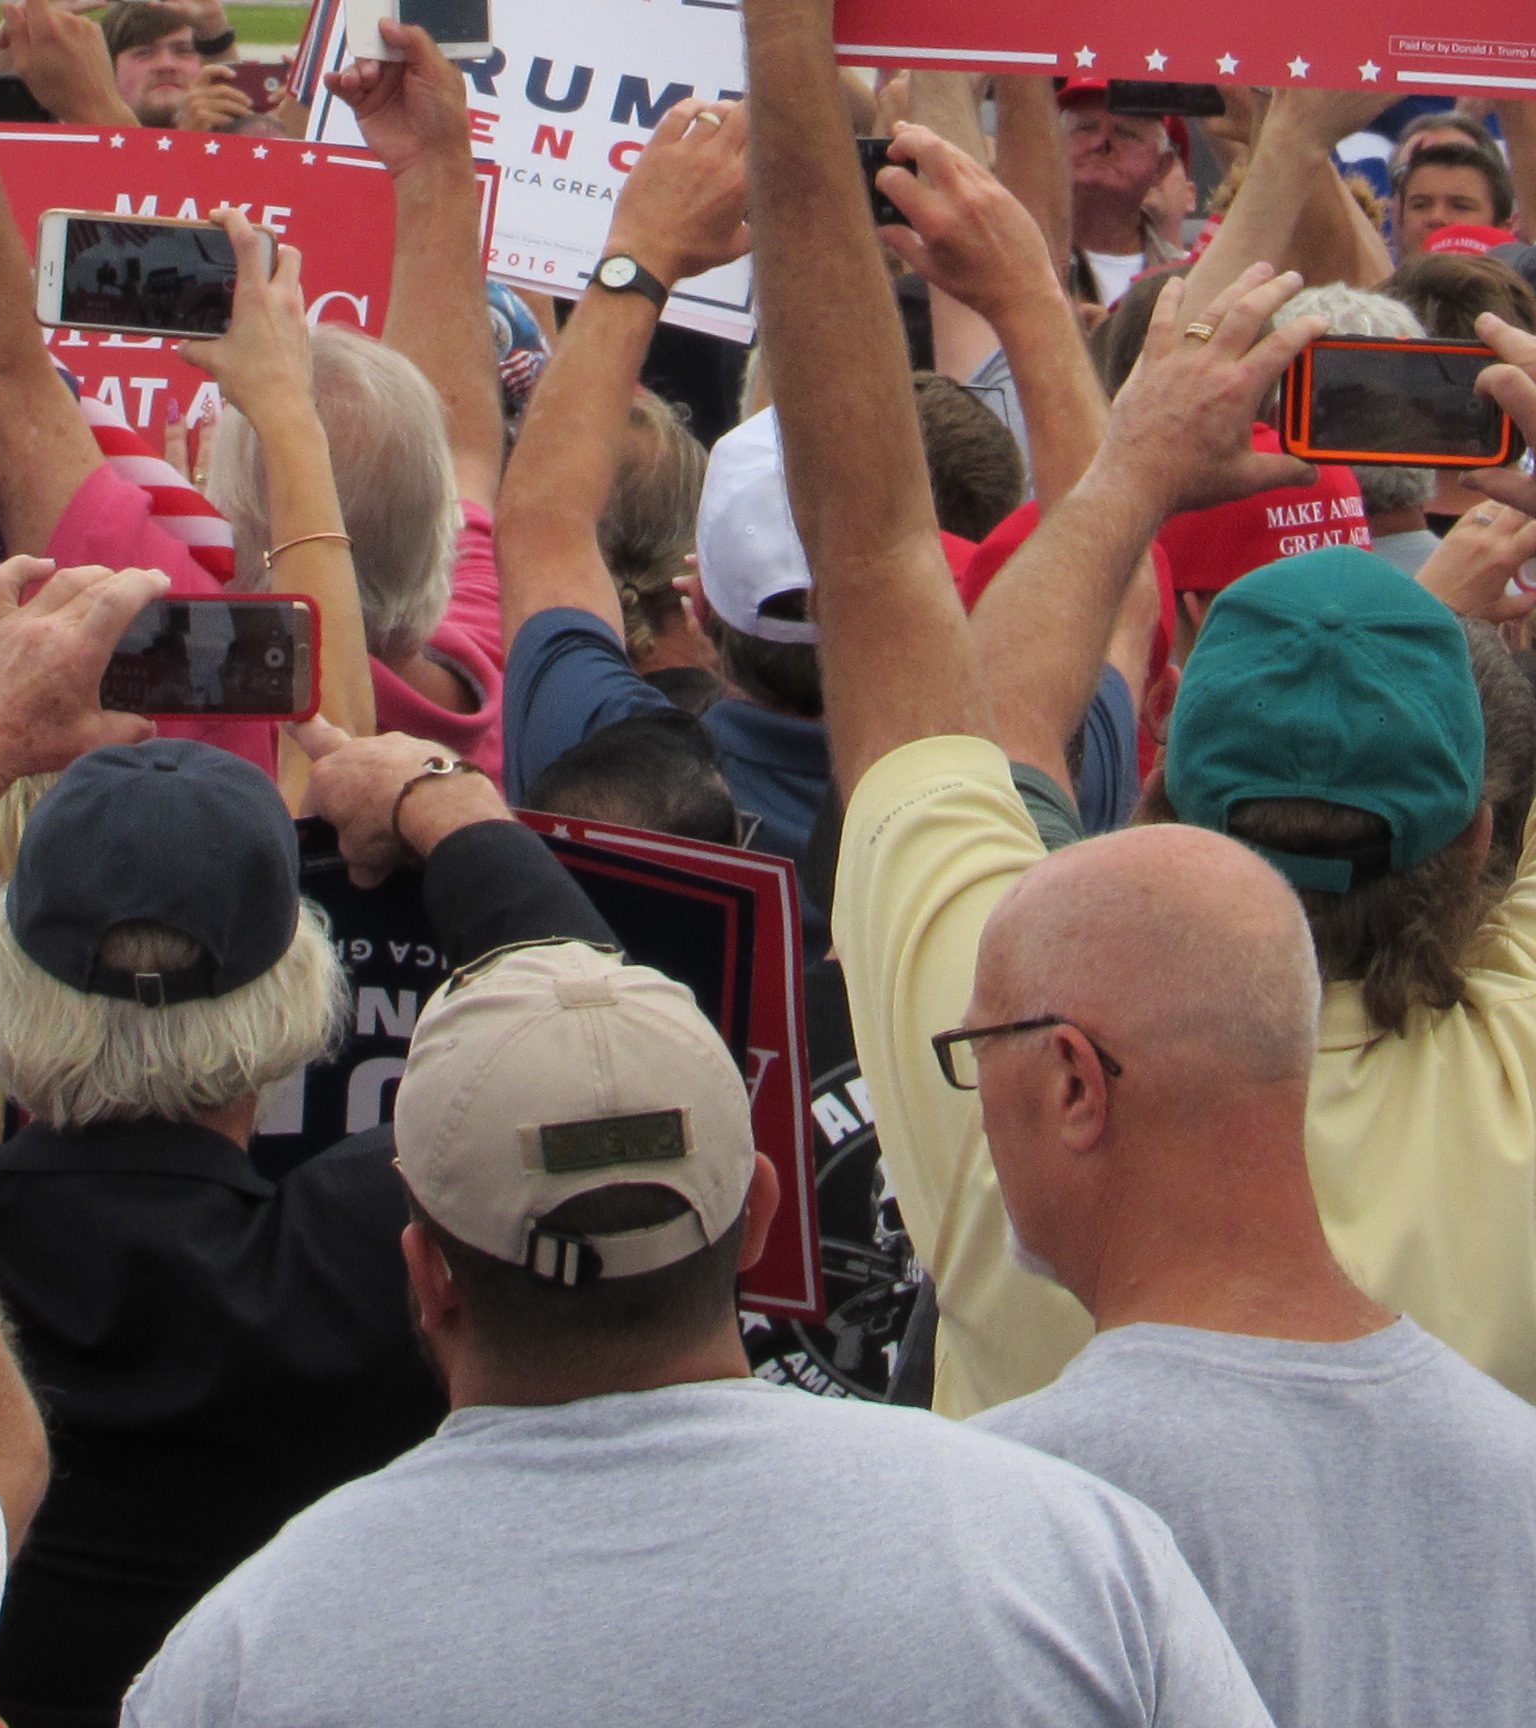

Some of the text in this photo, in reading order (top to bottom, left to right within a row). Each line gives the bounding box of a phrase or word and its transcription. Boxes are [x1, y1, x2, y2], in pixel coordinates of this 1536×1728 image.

[1399, 40, 1420, 52] Paid
[1422, 41, 1435, 52] for
[1438, 42, 1450, 55] by
[1451, 42, 1486, 54] Donald
[1498, 46, 1529, 58] Trump
[457, 46, 746, 131] RUM
[553, 177, 622, 202] GREA
[488, 249, 556, 274] 2016
[1266, 501, 1324, 529] MAKE
[1279, 530, 1342, 556] GREAT
